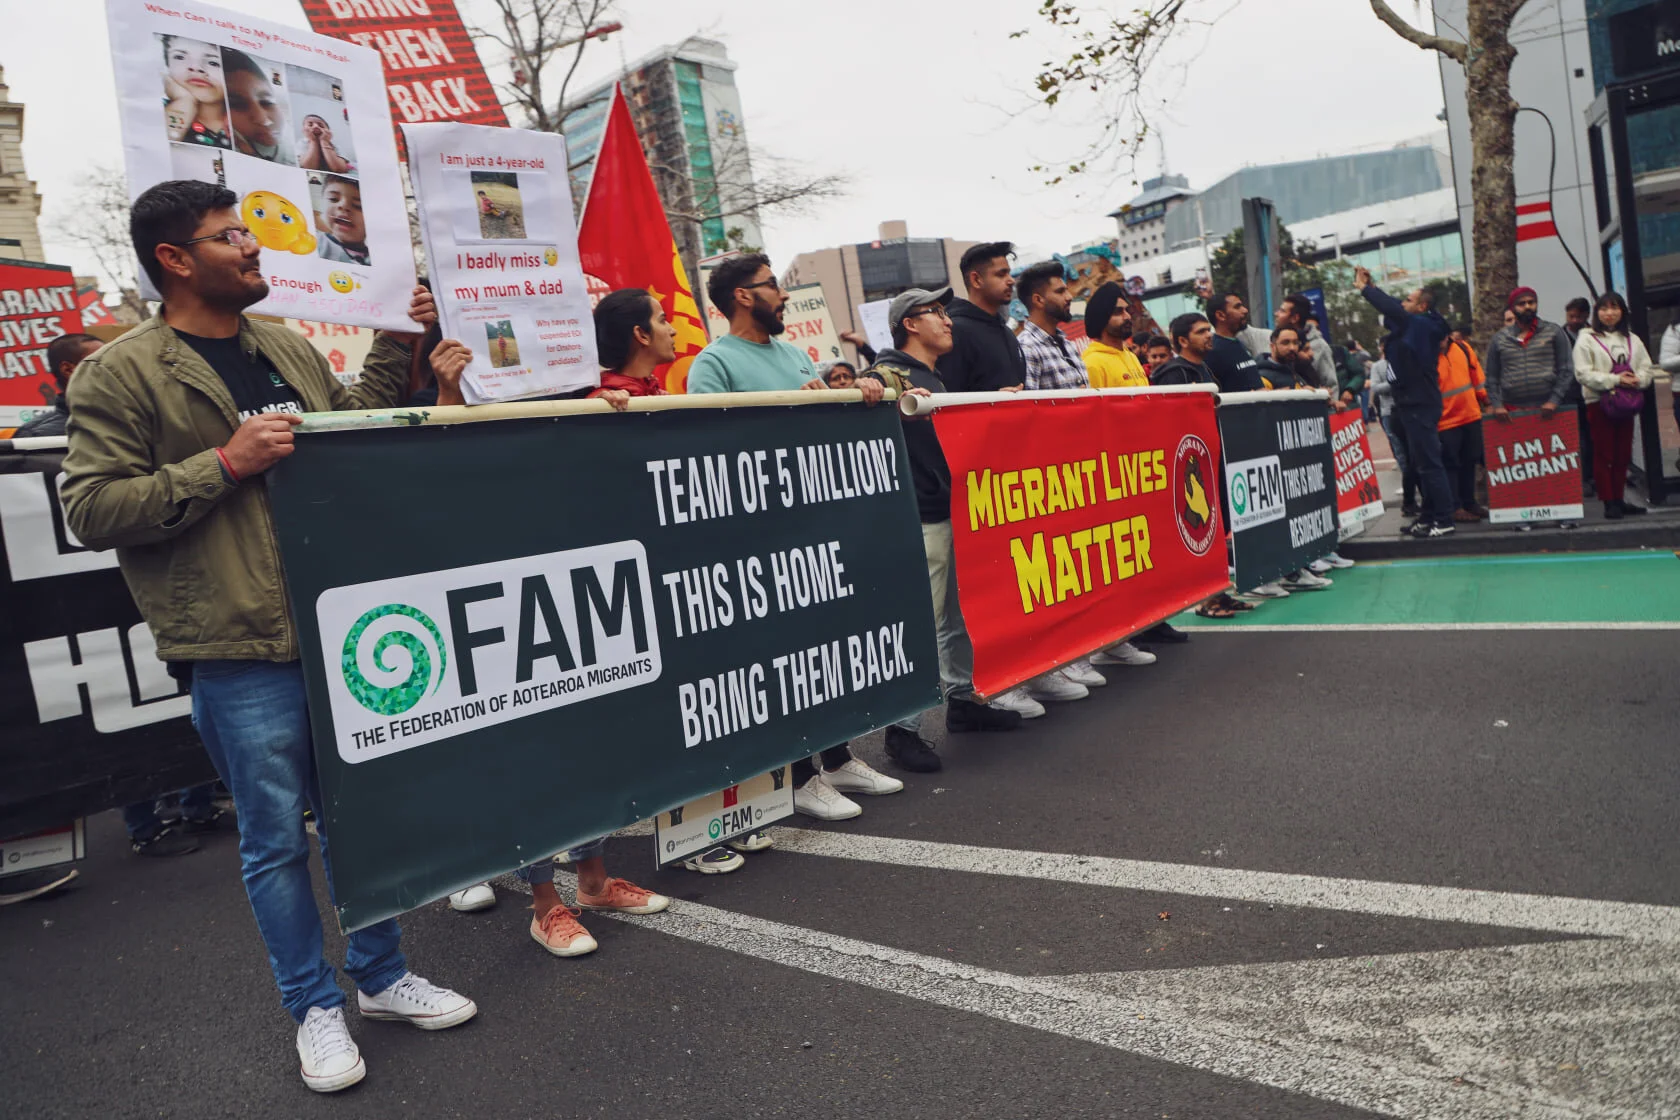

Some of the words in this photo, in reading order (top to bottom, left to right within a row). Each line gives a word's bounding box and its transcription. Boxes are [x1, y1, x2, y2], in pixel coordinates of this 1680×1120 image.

[144, 3, 181, 18] When
[184, 11, 206, 23] Can
[209, 16, 213, 24] I
[215, 18, 237, 31] talk
[239, 24, 251, 35] to
[253, 28, 271, 41] My
[273, 34, 312, 52] Parents
[231, 35, 263, 49] Time?
[349, 28, 455, 70] THEM
[389, 77, 481, 122] BACK
[440, 153, 445, 164] I
[447, 155, 463, 165] am
[466, 154, 485, 167] just
[488, 158, 494, 166] a
[496, 156, 544, 169] 4-year-old
[457, 254, 462, 269] I
[466, 252, 506, 272] badly
[511, 253, 541, 268] miss
[0, 286, 77, 317] RANT
[271, 276, 323, 293] Enough
[455, 287, 479, 302] my
[484, 285, 520, 298] mum
[524, 281, 536, 296] &
[539, 279, 563, 295] dad
[785, 318, 824, 342] STAY
[1178, 438, 1206, 461] MIGRANT
[1334, 442, 1364, 473] LIVES
[1497, 446, 1507, 464] I
[1513, 438, 1544, 461] AM
[1551, 433, 1567, 453] A
[646, 454, 734, 527] TEAM
[737, 450, 770, 514] OF
[775, 448, 794, 508] 5
[796, 437, 900, 505] MILLION?
[1336, 459, 1374, 496] MATTER
[1487, 451, 1579, 487] MIGRANT
[966, 459, 1098, 532] MIGRANT
[1101, 449, 1169, 502] LIVES
[1246, 463, 1283, 513] FAM
[1530, 508, 1551, 518] FAM
[1009, 514, 1154, 615] MATTER
[662, 562, 735, 638] THIS
[737, 556, 769, 621] IS
[770, 541, 855, 613] HOME.
[446, 558, 649, 698] FAM
[678, 662, 769, 749] BRING
[772, 640, 845, 716] THEM
[848, 621, 914, 692] BACK.
[352, 725, 386, 750] THE
[389, 700, 486, 741] FEDERATION
[489, 694, 508, 714] OF
[512, 676, 586, 707] AOTEAROA
[588, 658, 653, 686] MIGRANTS
[722, 805, 753, 836] FAM
